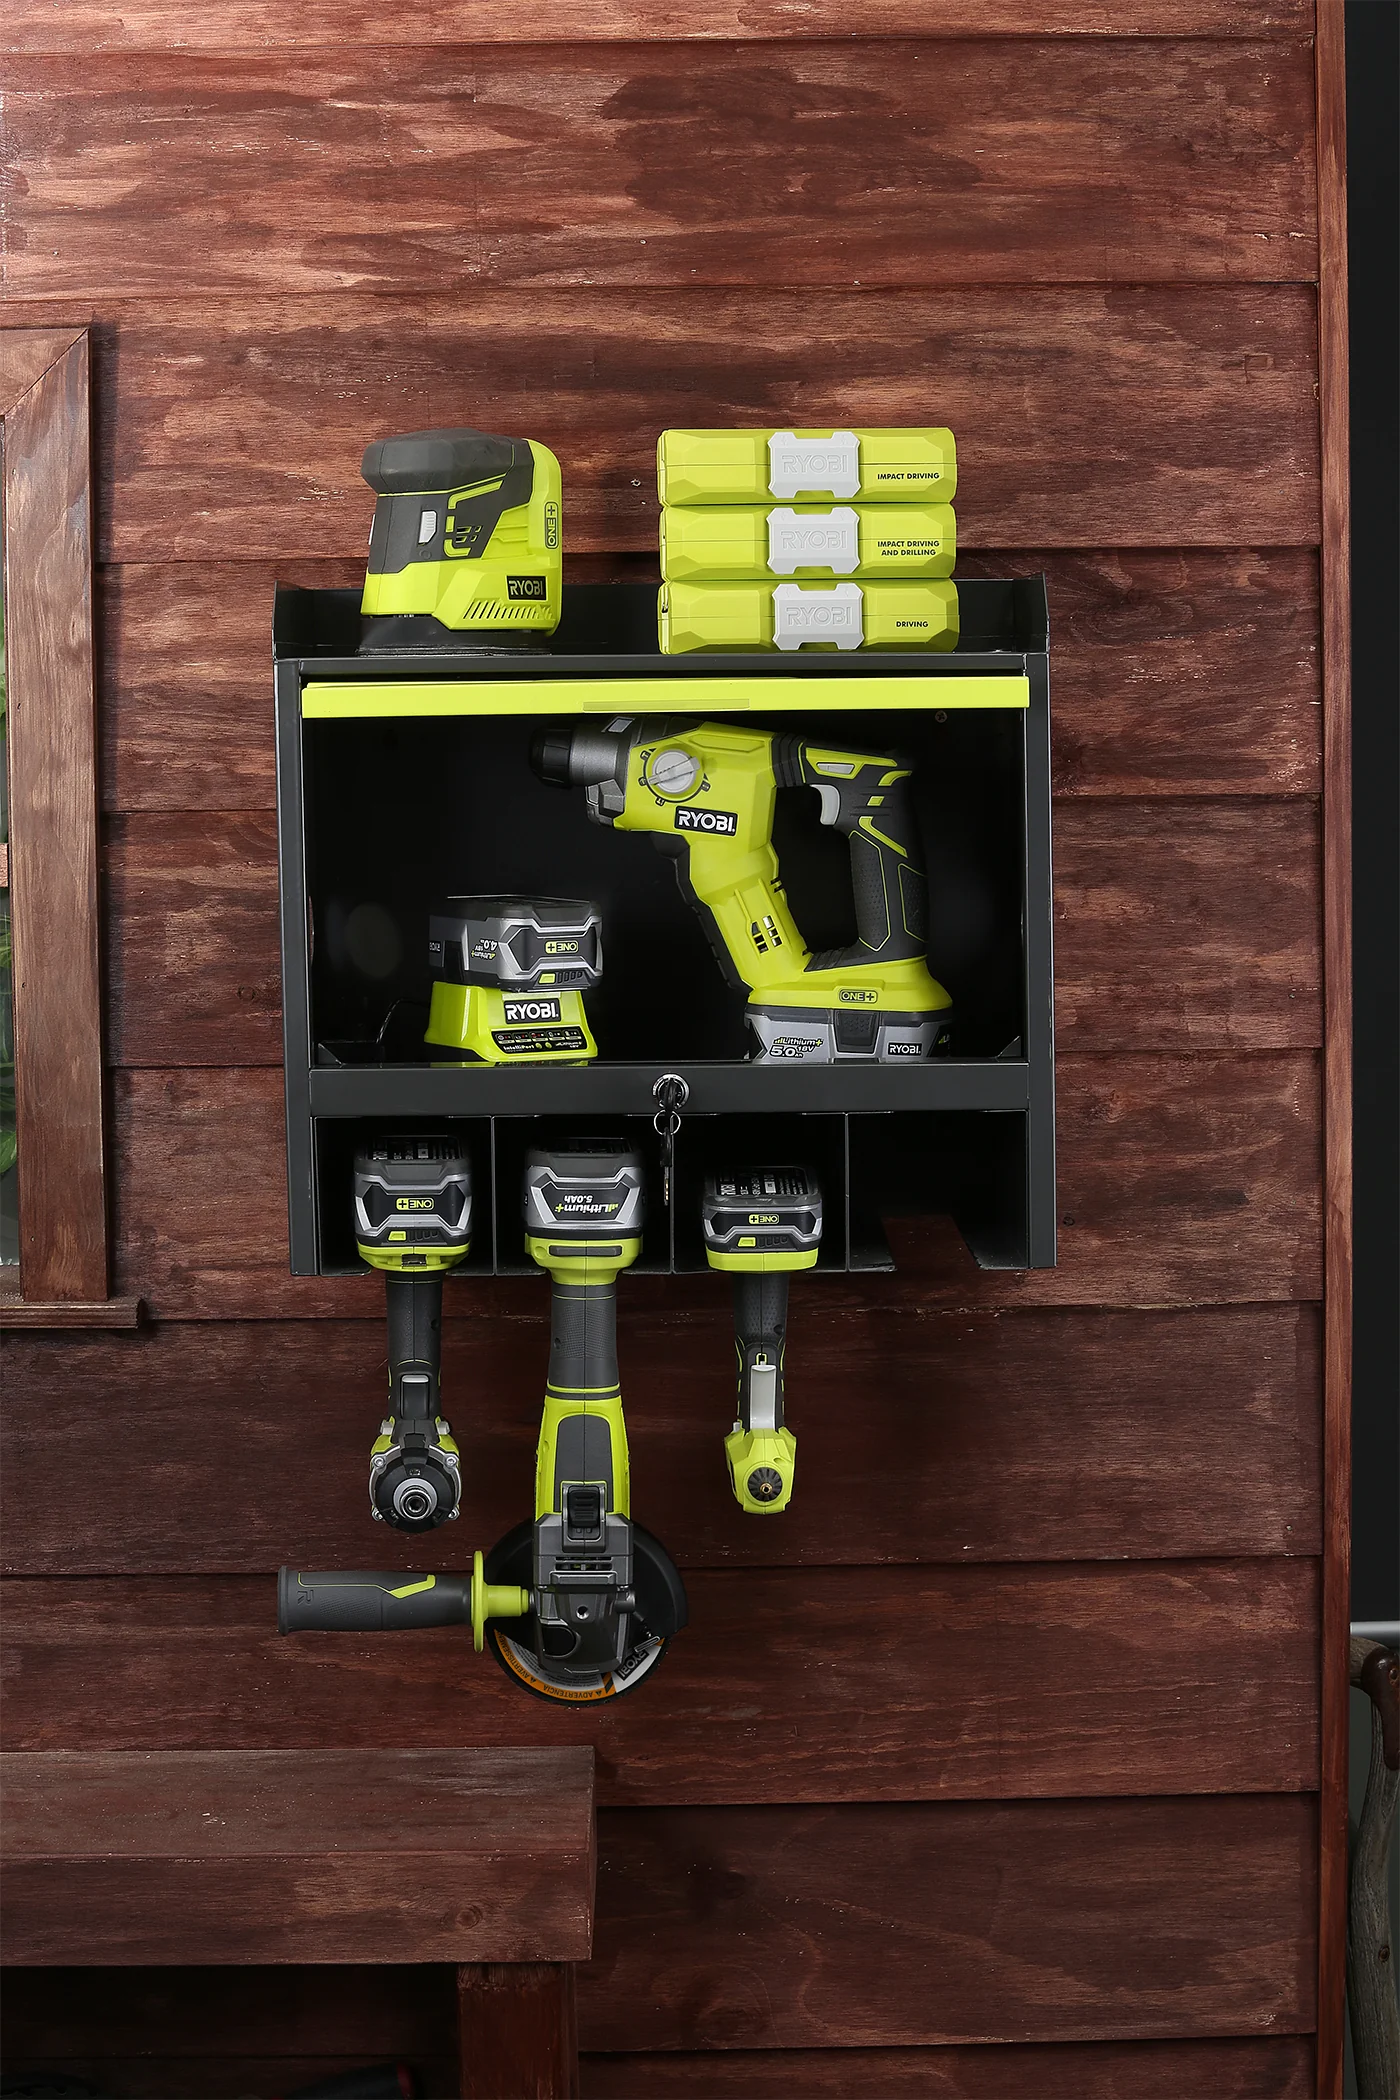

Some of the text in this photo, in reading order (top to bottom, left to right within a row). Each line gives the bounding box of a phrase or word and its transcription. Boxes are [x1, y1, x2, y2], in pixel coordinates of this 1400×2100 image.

[780, 454, 848, 474] RYOBI
[877, 472, 940, 481] IMPACT DRIVING
[779, 530, 847, 550] RYOBI
[877, 540, 940, 548] IMPACT DRIVING
[900, 549, 936, 557] DRILLING
[508, 579, 544, 597] RYOBI
[785, 606, 853, 626] RYOBI
[896, 620, 929, 628] DRIVING
[677, 810, 736, 833] RYOBI
[505, 1002, 559, 1021] RYOBI
[889, 1044, 921, 1055] RYOBI
[564, 1194, 593, 1204] 5.0Ah
[543, 1684, 594, 1699] ADVERTENCIA
